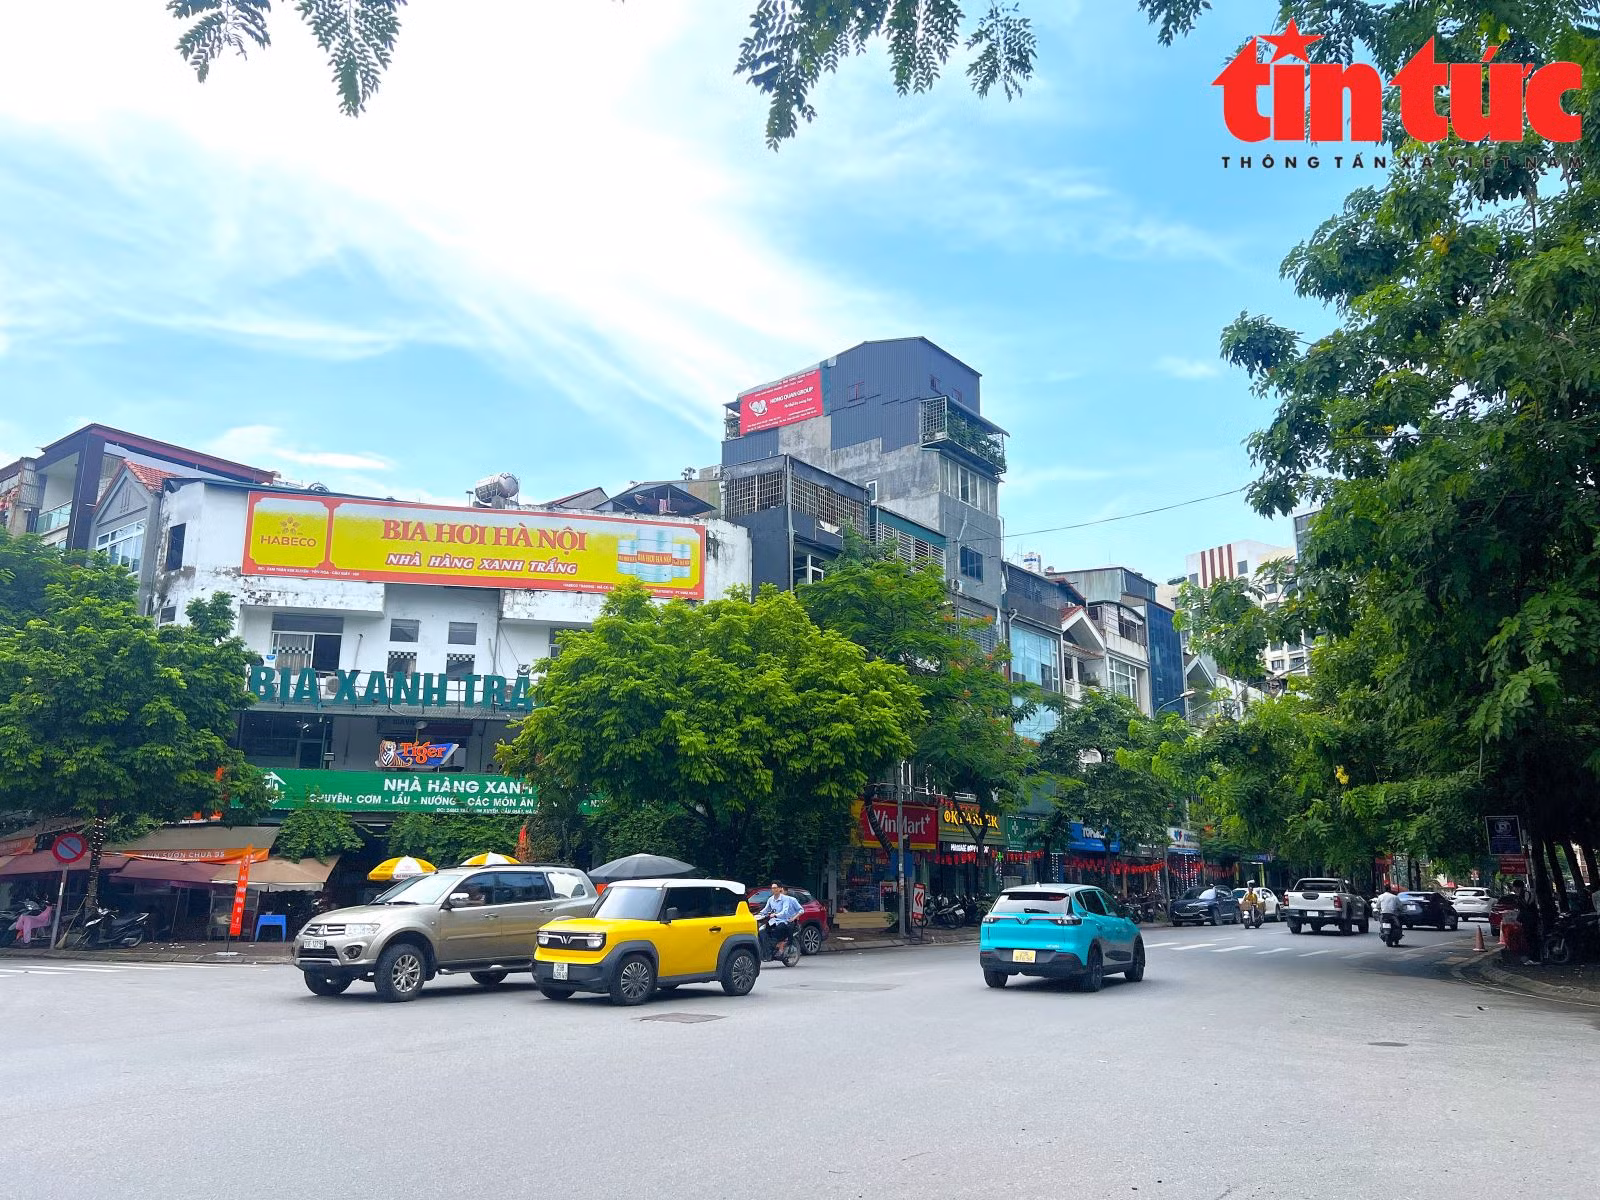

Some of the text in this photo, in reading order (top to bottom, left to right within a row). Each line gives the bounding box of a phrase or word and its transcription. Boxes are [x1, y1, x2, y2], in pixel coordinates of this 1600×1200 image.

[260, 534, 317, 548] HABECO
[381, 518, 588, 556] BIA HƠI HÀ NỘI
[386, 551, 578, 575] NHÀ HÀNG XANH TRẮNG
[249, 664, 545, 711] BIA XANH TRẮ
[400, 741, 447, 764] Tiger
[383, 775, 533, 794] NHÀ HÀNG XANH
[356, 793, 382, 804] CƠM
[391, 791, 411, 805] LẨU
[467, 795, 490, 807] CÁC
[493, 796, 517, 807] MÓN
[519, 797, 534, 807] ĂN
